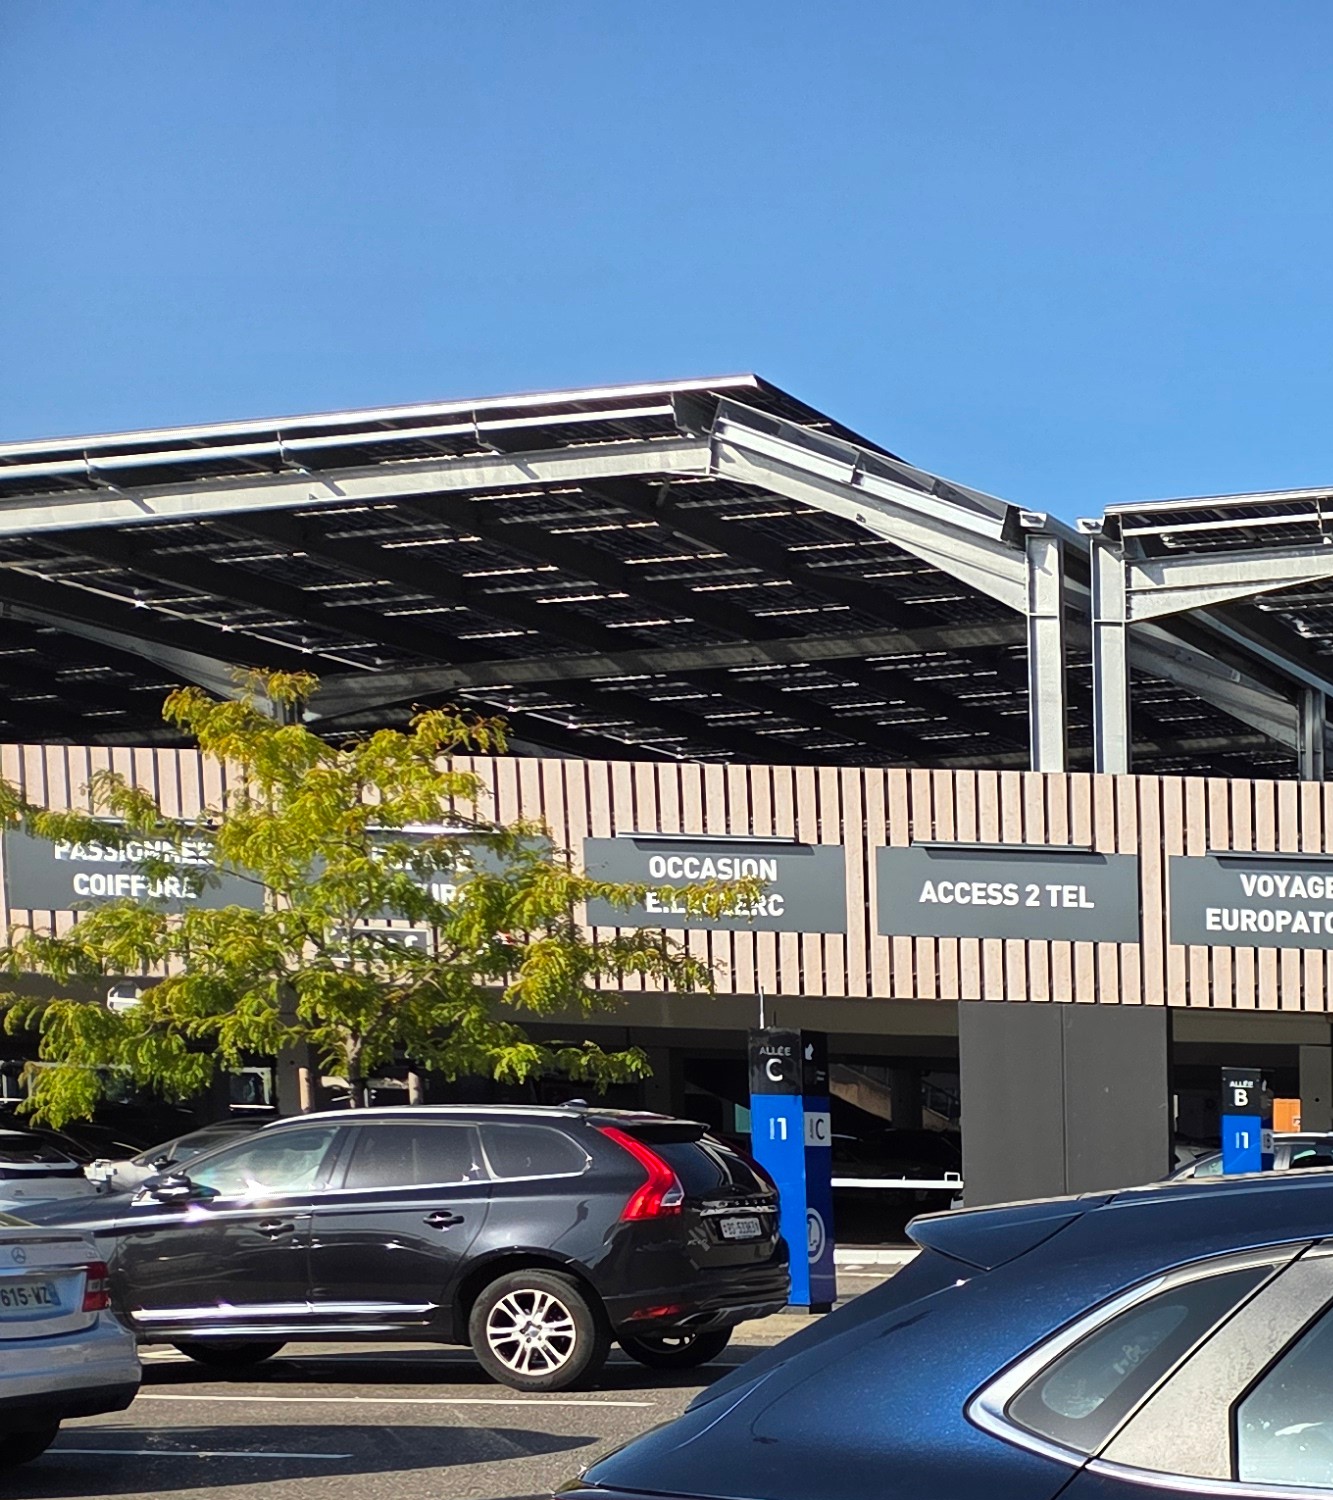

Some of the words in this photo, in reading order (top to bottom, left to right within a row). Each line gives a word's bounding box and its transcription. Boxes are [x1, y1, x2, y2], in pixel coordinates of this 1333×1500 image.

[649, 855, 777, 881] OCCASION
[73, 873, 197, 899] COIFFURE
[919, 880, 1020, 906] ACCESS
[1025, 883, 1041, 907] 2
[1046, 884, 1095, 909] TEL
[766, 1058, 783, 1082] C
[1234, 1088, 1248, 1106] B
